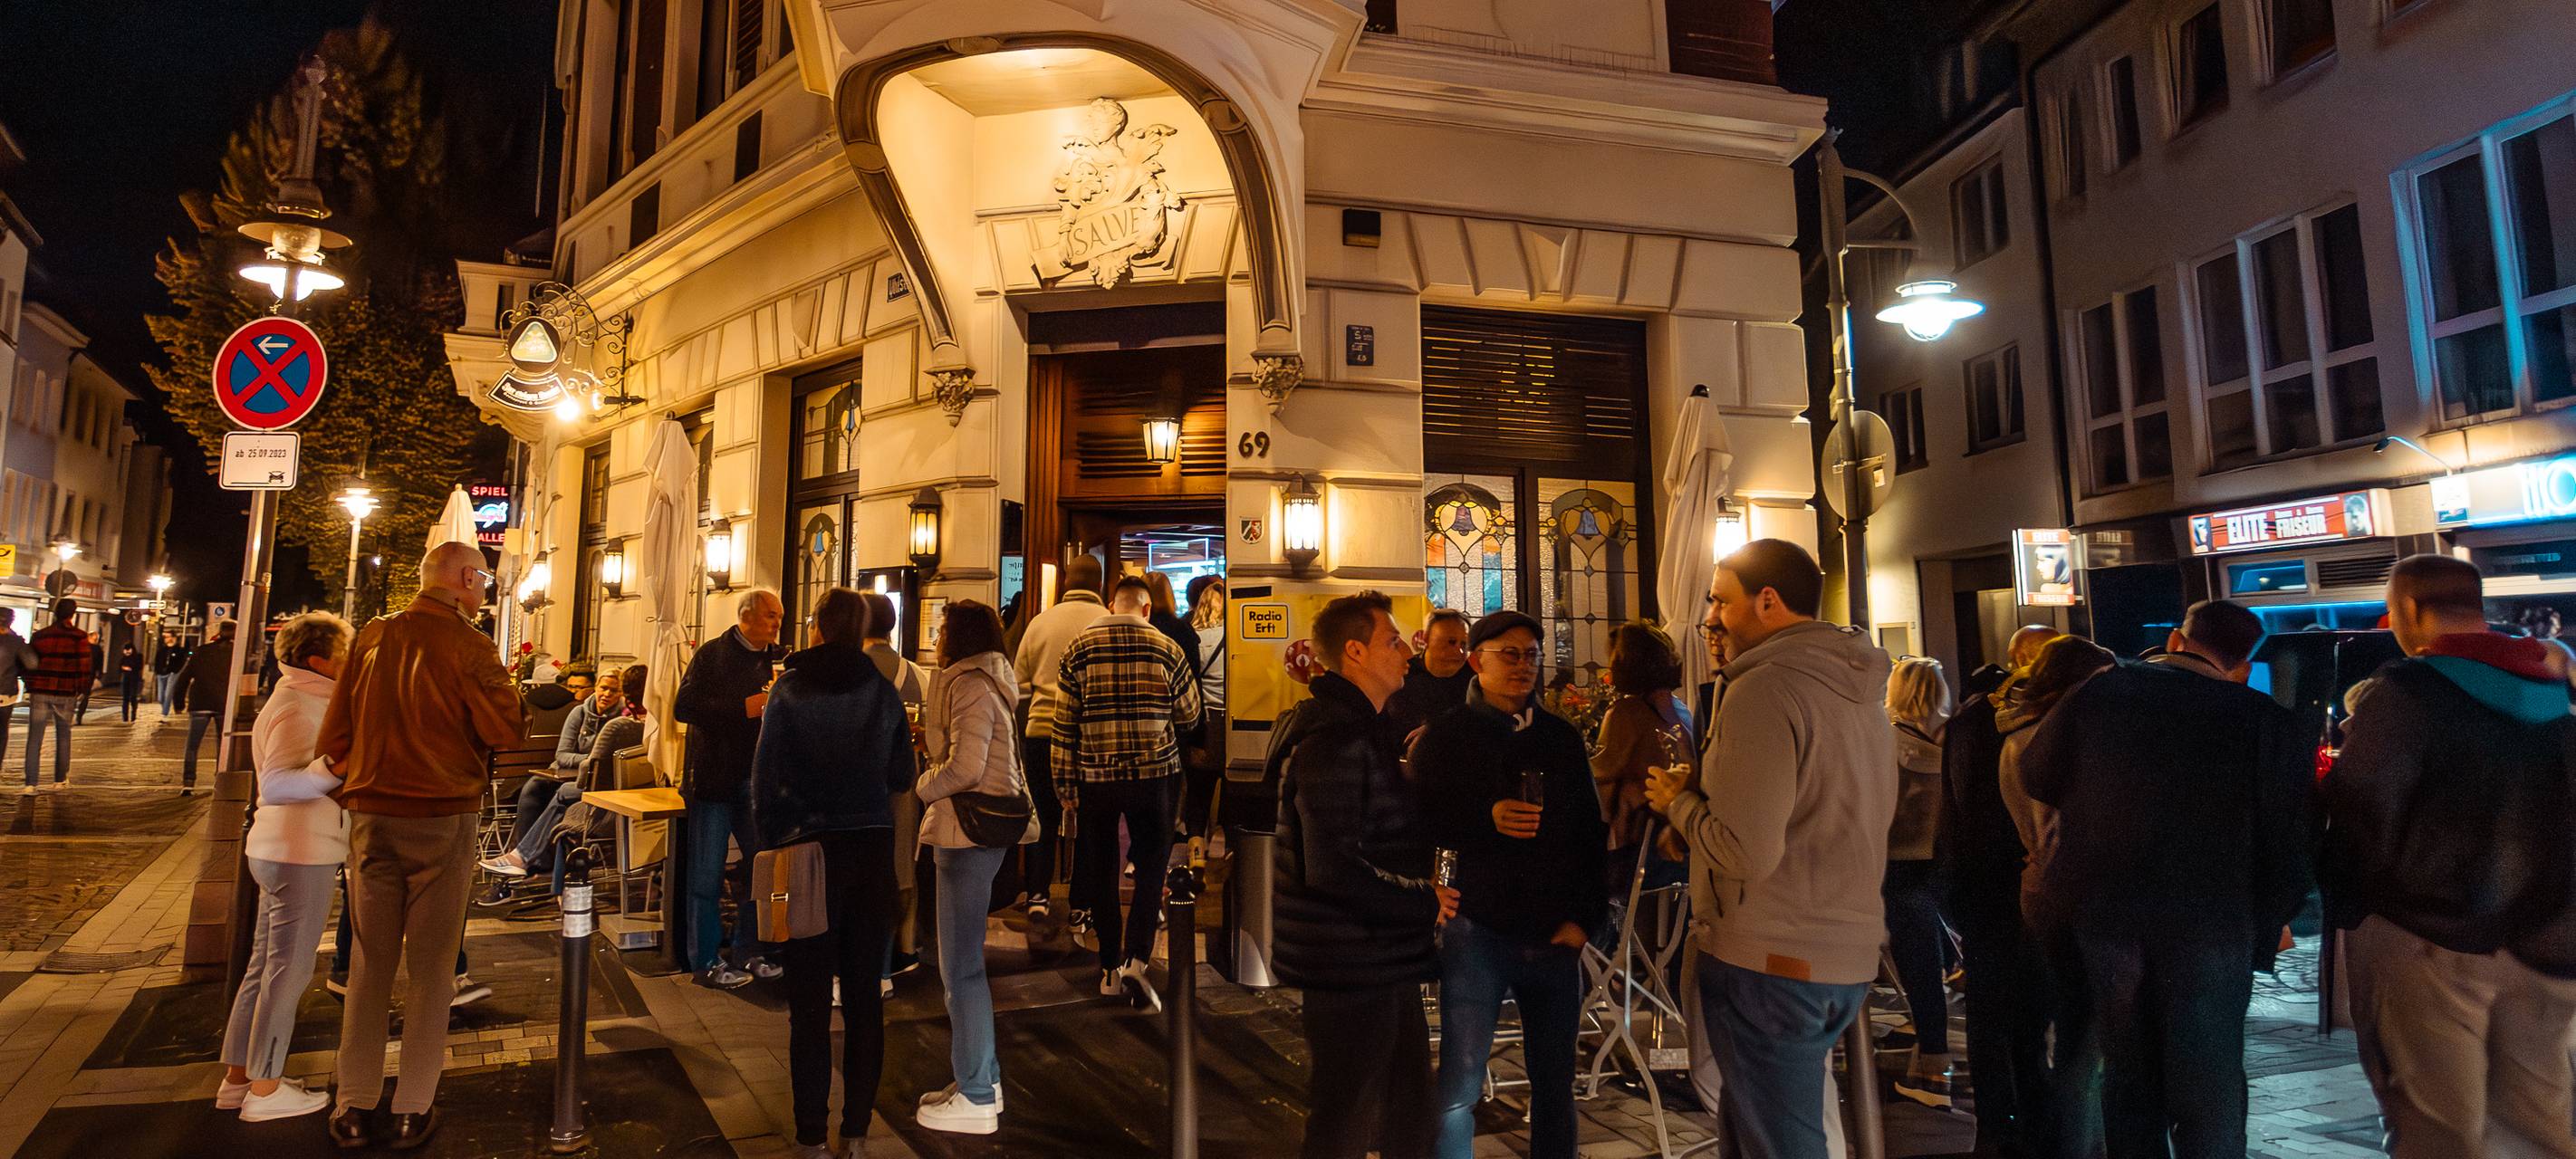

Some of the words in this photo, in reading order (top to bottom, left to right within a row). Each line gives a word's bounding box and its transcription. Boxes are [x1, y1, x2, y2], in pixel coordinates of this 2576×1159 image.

[1073, 206, 1139, 255] SALVE
[1238, 431, 1270, 458] 69
[472, 486, 509, 497] SPIEL
[2226, 513, 2270, 544] ELITE
[477, 532, 505, 542] ALLE
[1249, 610, 1282, 621] Radio
[1255, 623, 1275, 634] Erft
